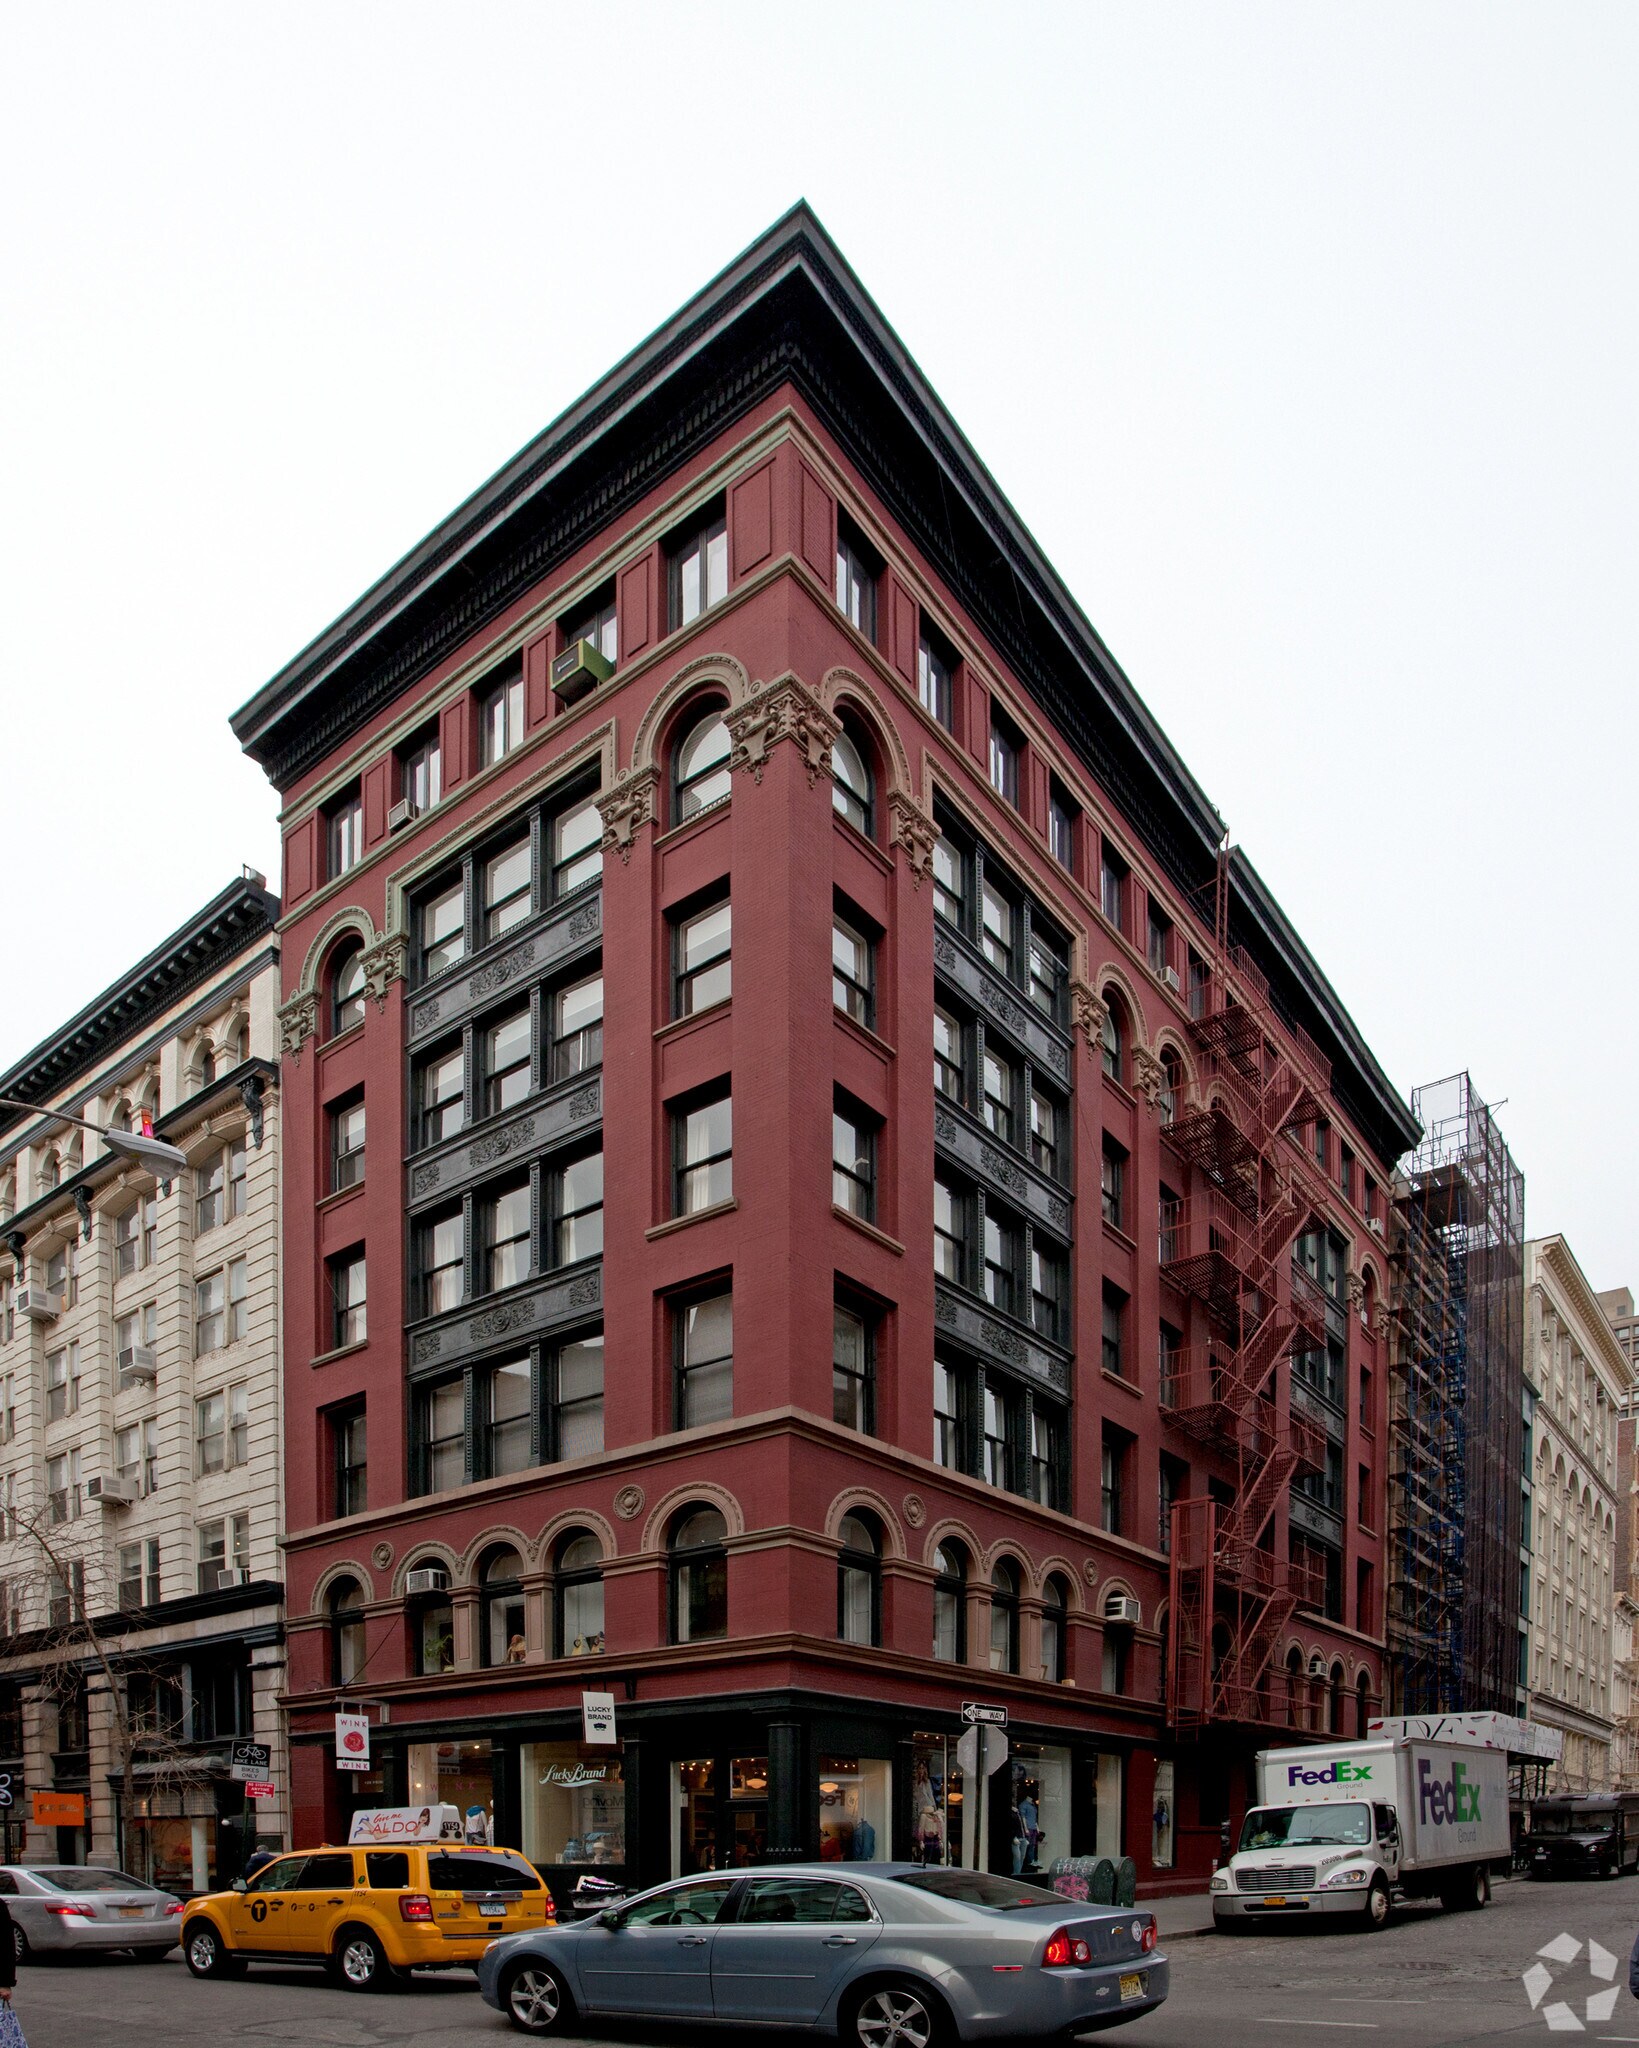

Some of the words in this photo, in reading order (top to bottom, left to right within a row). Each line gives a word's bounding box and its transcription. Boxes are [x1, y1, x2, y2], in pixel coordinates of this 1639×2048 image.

[967, 1709, 982, 1718] ONE
[340, 1719, 366, 1728] WINK
[342, 1762, 368, 1770] WINK
[539, 1764, 573, 1785] Lucky
[566, 1762, 607, 1783] Brand
[1288, 1761, 1373, 1787] FedEx
[1336, 1782, 1363, 1790] Ground
[1418, 1758, 1482, 1825] FedEx
[373, 1813, 390, 1823] Give
[372, 1821, 419, 1834] ALDO
[443, 1822, 459, 1831] 1Y54
[254, 1903, 265, 1920] T
